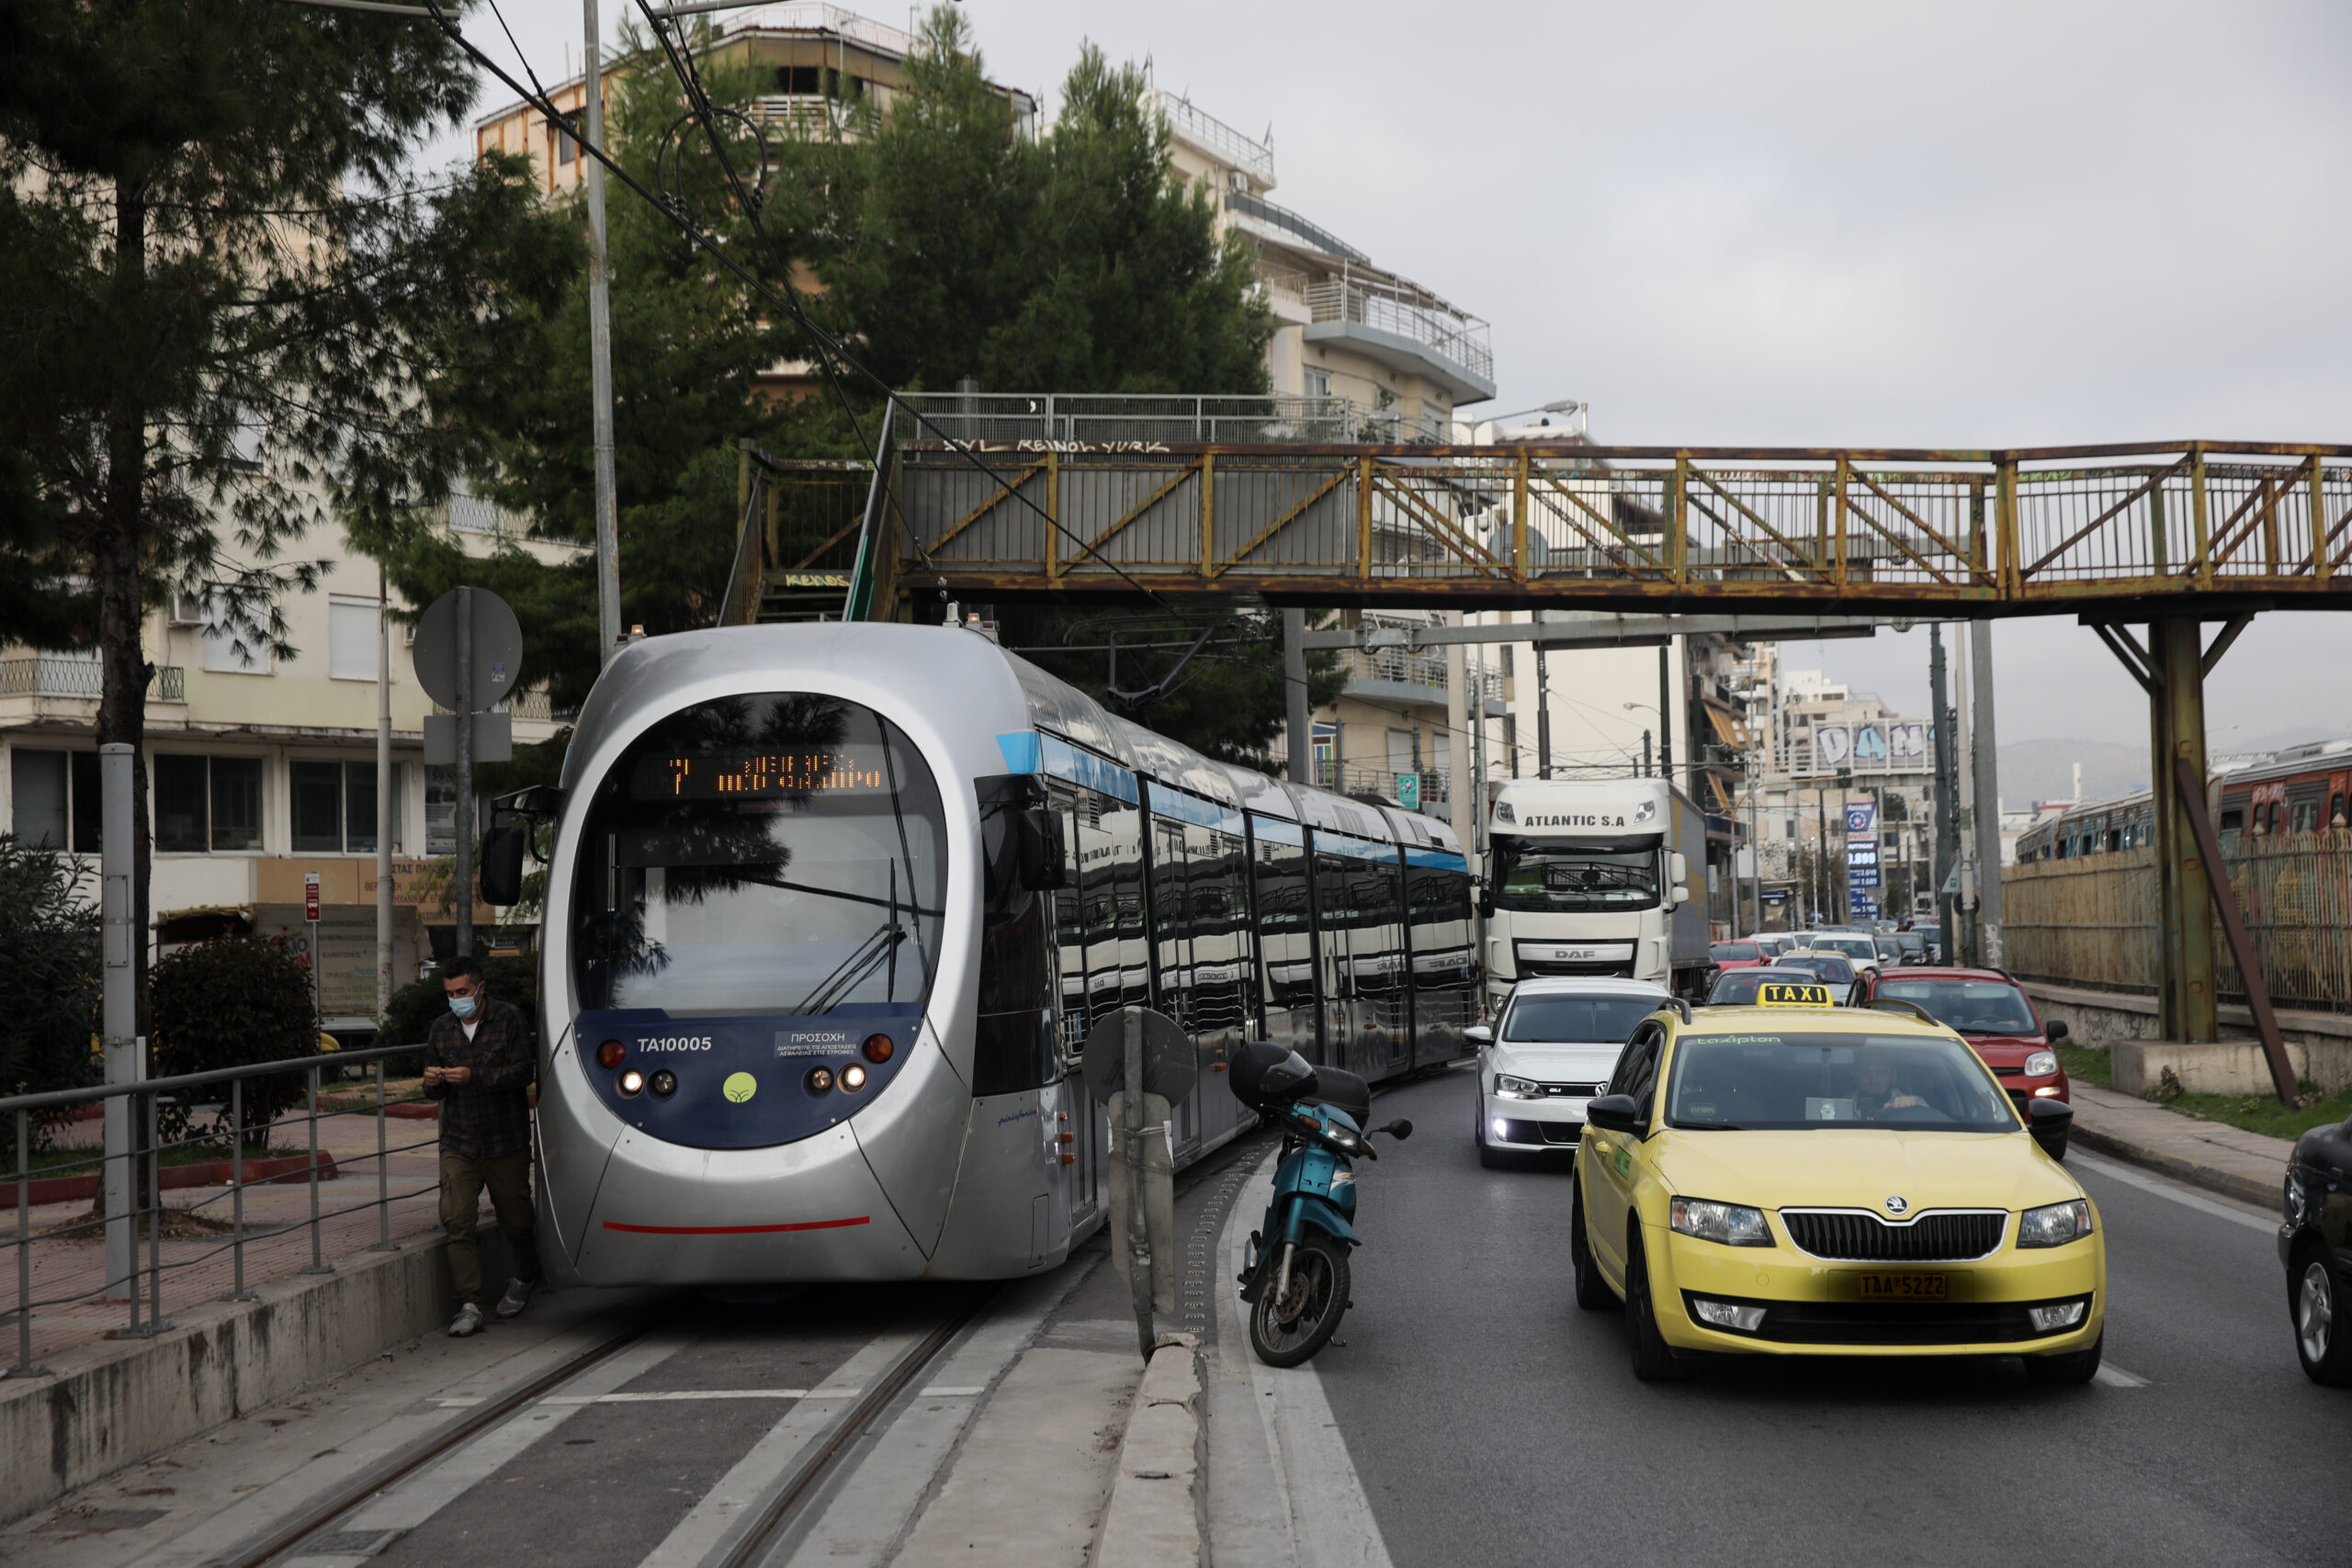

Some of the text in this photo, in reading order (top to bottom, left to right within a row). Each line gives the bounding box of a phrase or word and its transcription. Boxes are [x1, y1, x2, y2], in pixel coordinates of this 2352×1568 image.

[1817, 724, 1935, 765] DAN
[1525, 815, 1625, 827] ATLANTIC S.A
[1555, 950, 1596, 959] DAF
[1769, 986, 1823, 1001] TAXI
[637, 1036, 712, 1053] TA10005
[791, 1032, 845, 1043] ΠΡΟΣΟΧΗ
[1902, 1276, 1943, 1294] 5222
